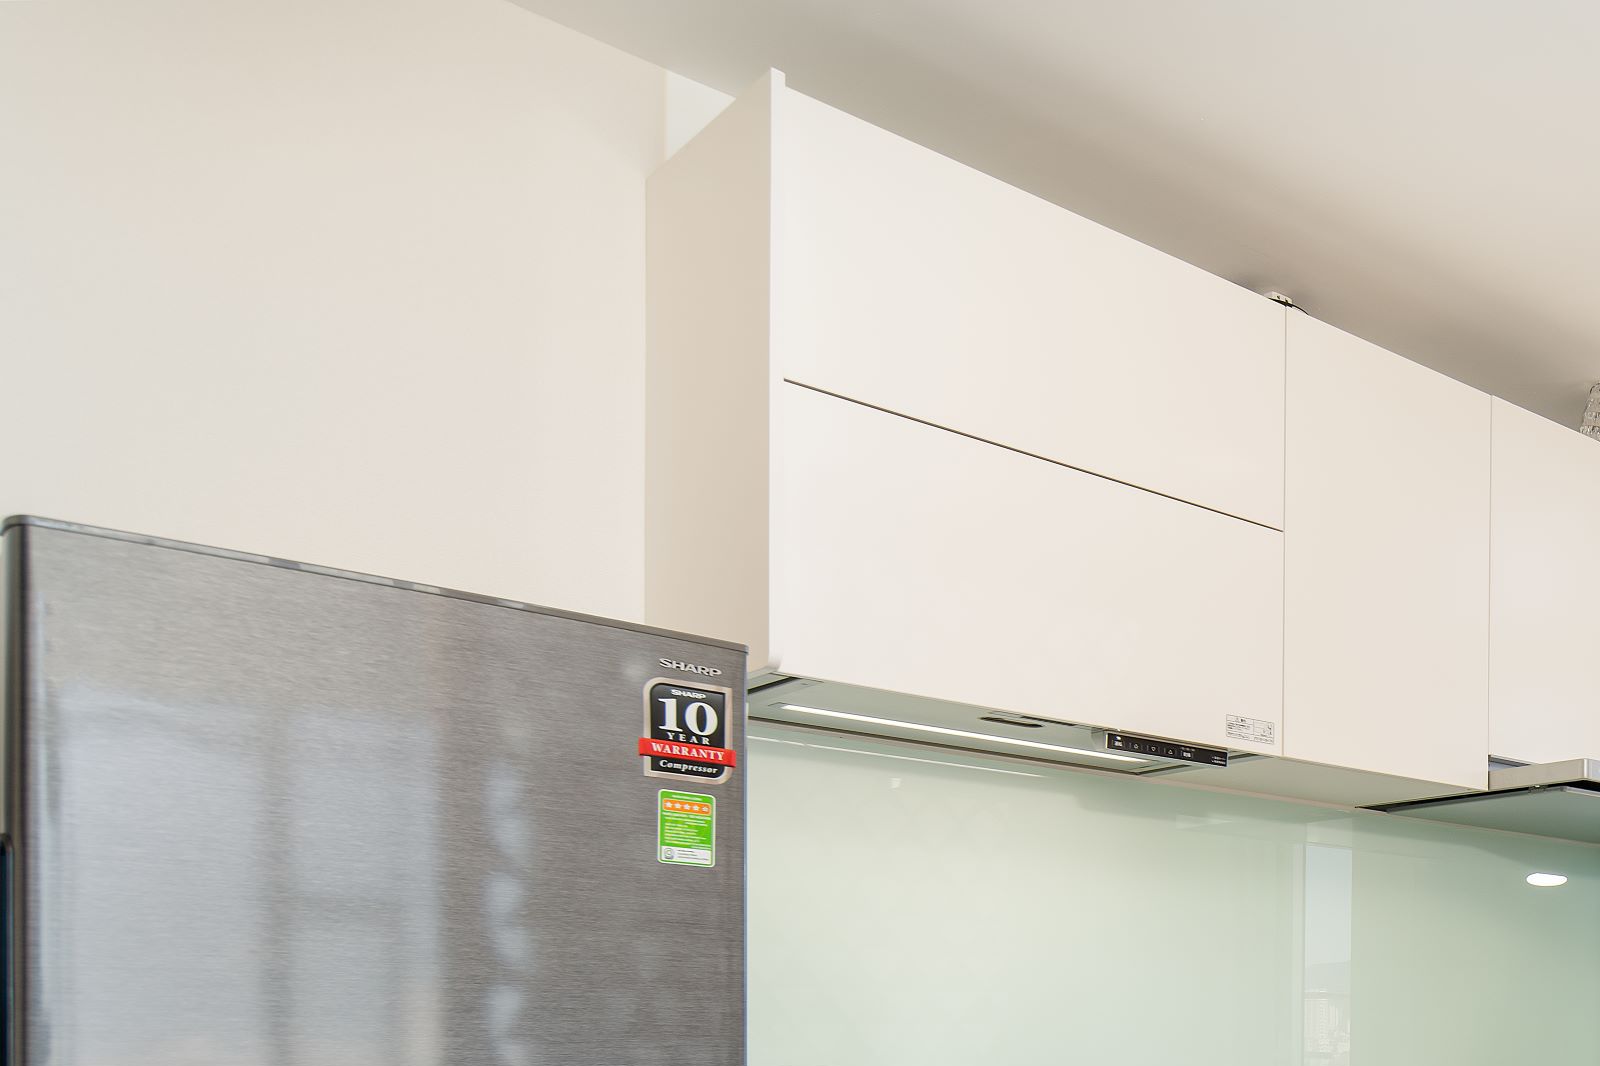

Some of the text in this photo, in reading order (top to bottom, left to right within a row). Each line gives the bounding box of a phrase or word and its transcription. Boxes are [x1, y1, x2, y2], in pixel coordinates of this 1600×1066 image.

[659, 658, 722, 676] SHARP
[671, 689, 706, 699] SHARP
[658, 698, 718, 736] 10
[666, 732, 710, 745] YEAR
[651, 742, 725, 760] WARRANTY
[660, 760, 718, 774] Compressor
